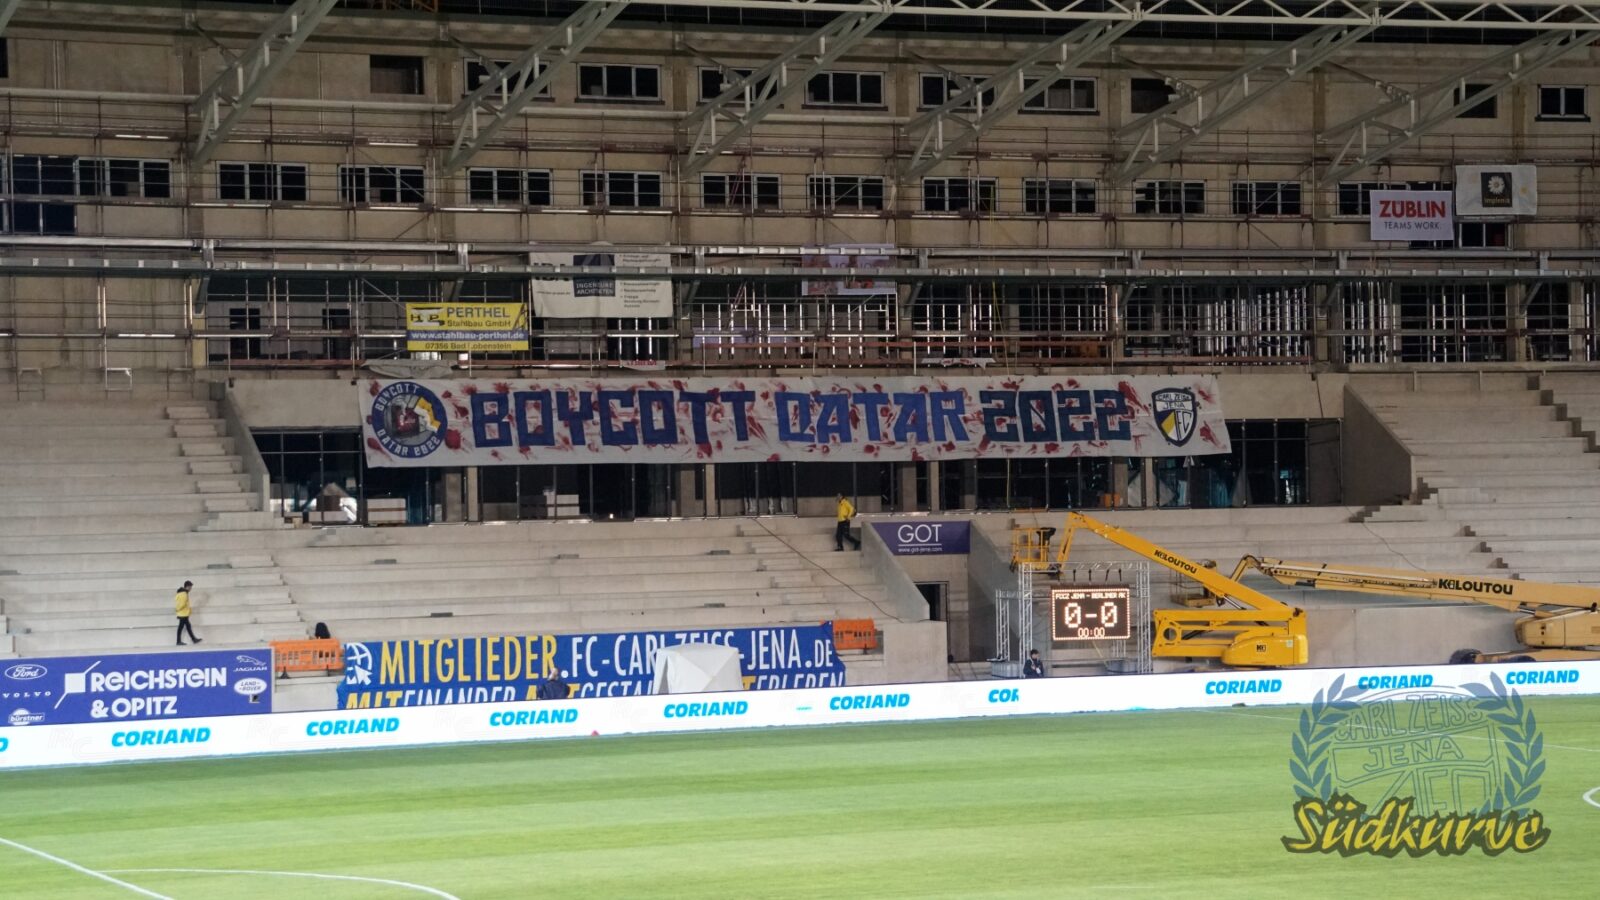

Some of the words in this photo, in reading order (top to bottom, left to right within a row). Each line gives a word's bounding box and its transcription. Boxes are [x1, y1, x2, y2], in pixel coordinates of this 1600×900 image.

[1379, 200, 1446, 218] ZÜBLIN
[1384, 221, 1412, 230] TEAMS
[447, 306, 510, 318] PERTHEL
[411, 331, 524, 340] www.stahlbau-perthel.de
[374, 383, 420, 412] BOYCOTT
[471, 390, 756, 448] BOYCOTT
[774, 390, 970, 444] QATAR
[979, 389, 1132, 443] 2022
[898, 524, 942, 543] GOT
[1078, 627, 1105, 639] 00:00
[12, 666, 40, 678] Ford
[1506, 670, 1579, 684] CORIAND
[1205, 679, 1282, 694] CORIAND
[1357, 674, 1433, 690] CORIAND
[2, 691, 52, 699] VOLVO
[829, 693, 910, 710] CORIAND
[489, 709, 578, 726] CORIAND
[663, 701, 748, 718] CORIAND
[306, 718, 400, 736] CORIAND
[111, 728, 211, 747] CORIAND
